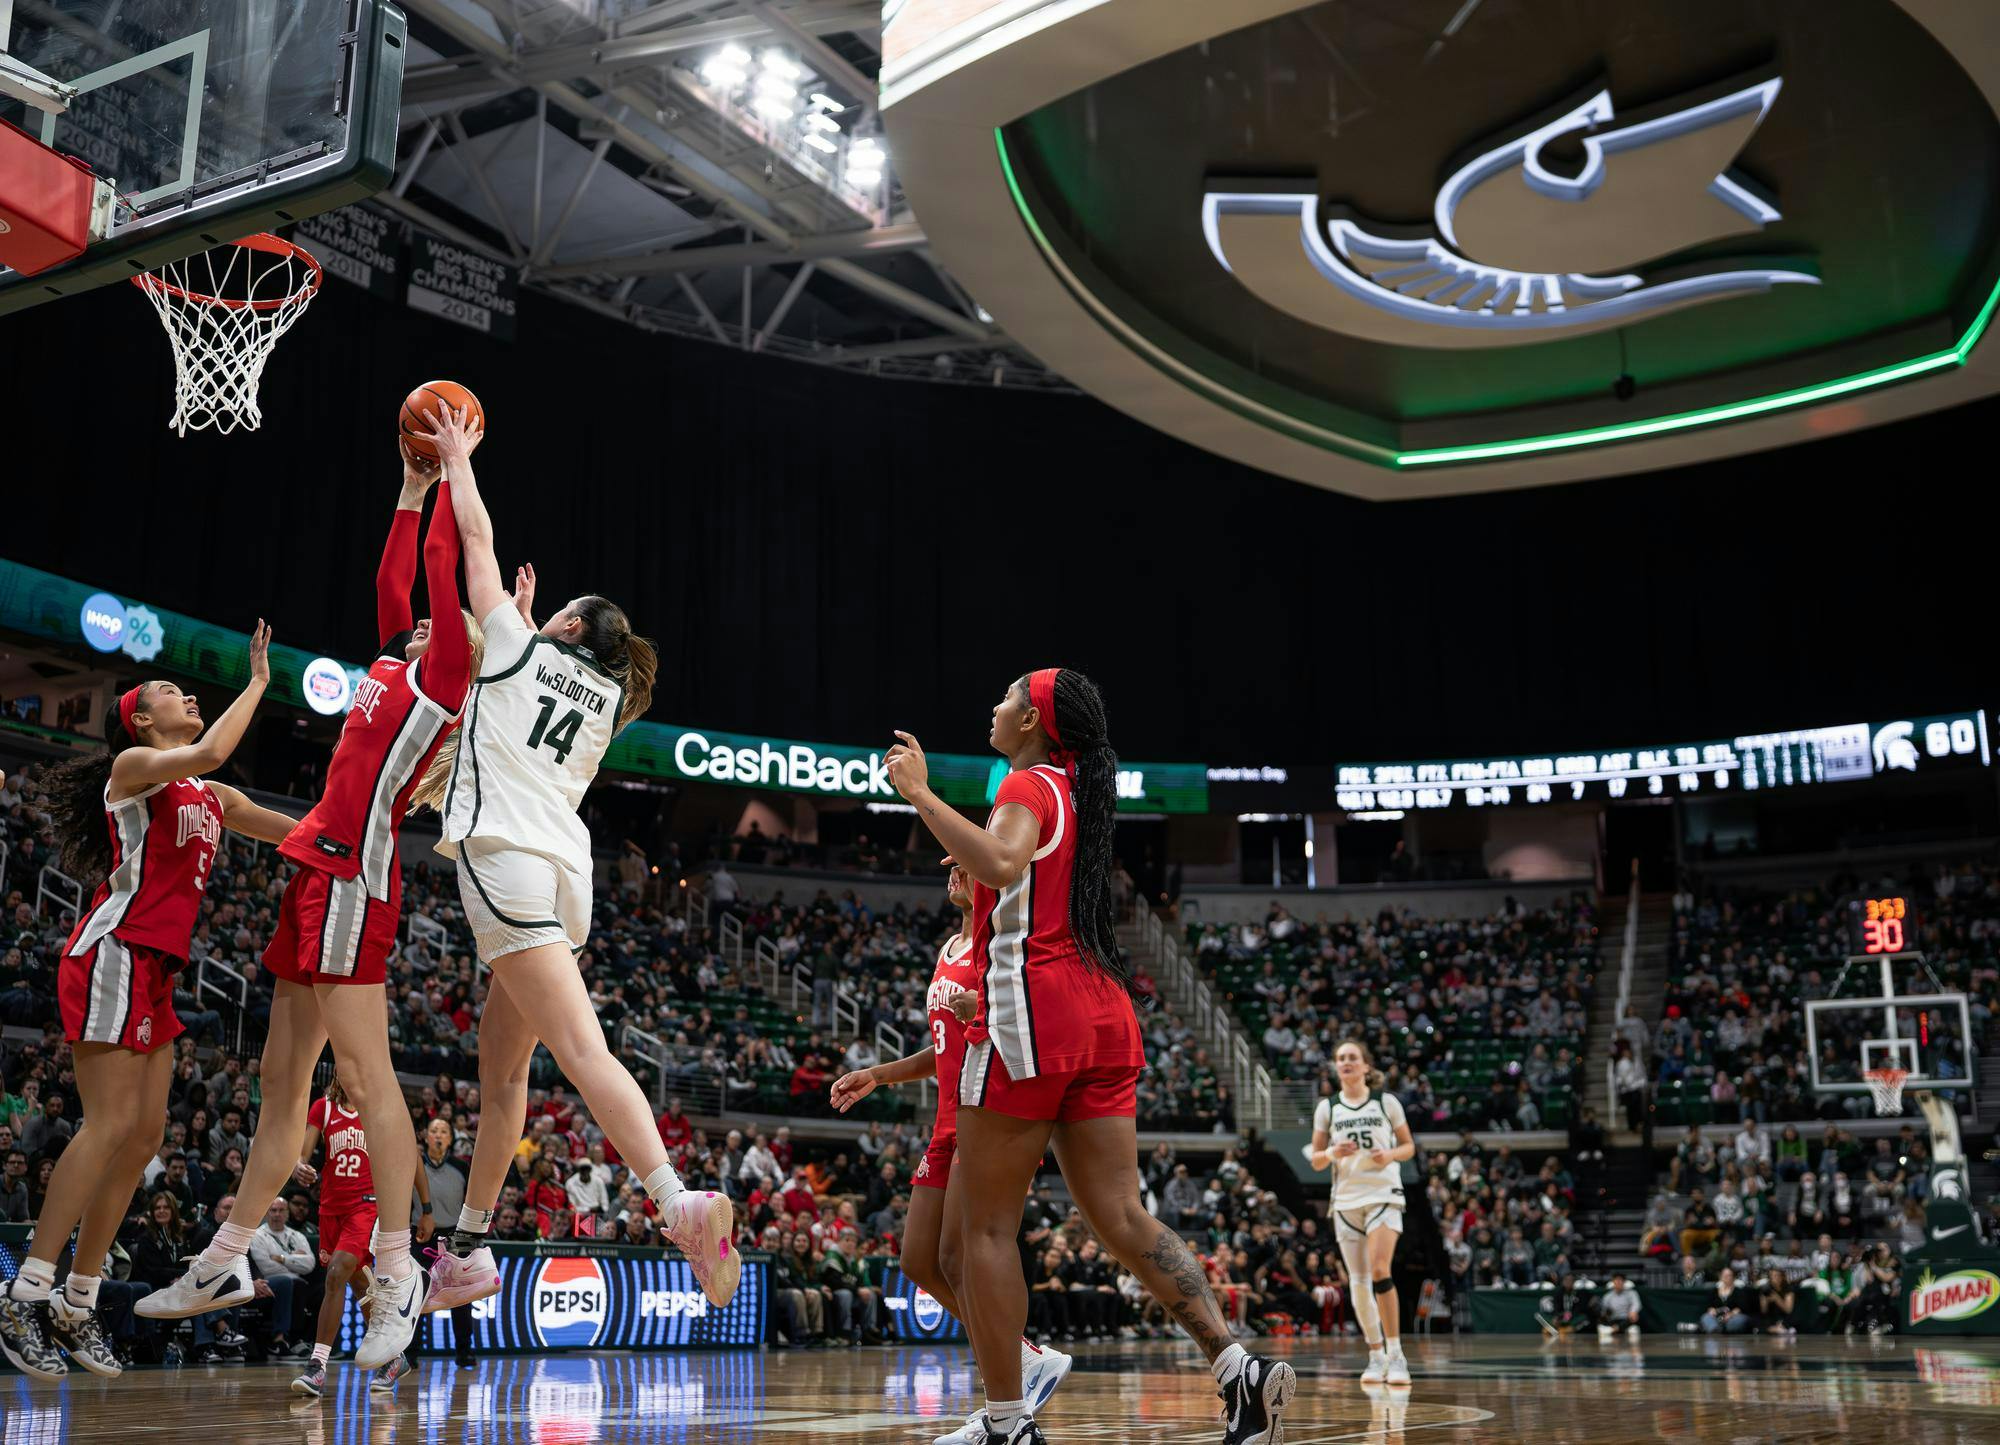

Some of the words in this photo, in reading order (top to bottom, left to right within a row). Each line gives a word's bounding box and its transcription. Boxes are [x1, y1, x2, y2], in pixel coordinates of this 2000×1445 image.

[299, 219, 396, 274] CHAMPIONS
[350, 222, 380, 248] TEN
[327, 252, 365, 282] 2011
[426, 240, 506, 282] WOMEN'S
[433, 259, 463, 282] BIG
[467, 270, 499, 294] TEN
[413, 268, 516, 316] CHAMPIONS
[441, 300, 485, 325] 2014
[526, 695, 585, 765] 14
[1925, 719, 1976, 757] 60
[675, 732, 895, 796] CashBack
[1864, 918, 1904, 954] 30
[934, 1019, 946, 1055] 3
[1347, 1130, 1374, 1150] 35
[335, 1154, 361, 1177] 22
[540, 1291, 600, 1313] PEPSI
[641, 1290, 707, 1318] PEPSI
[1909, 1276, 1992, 1324] LIBMAN
